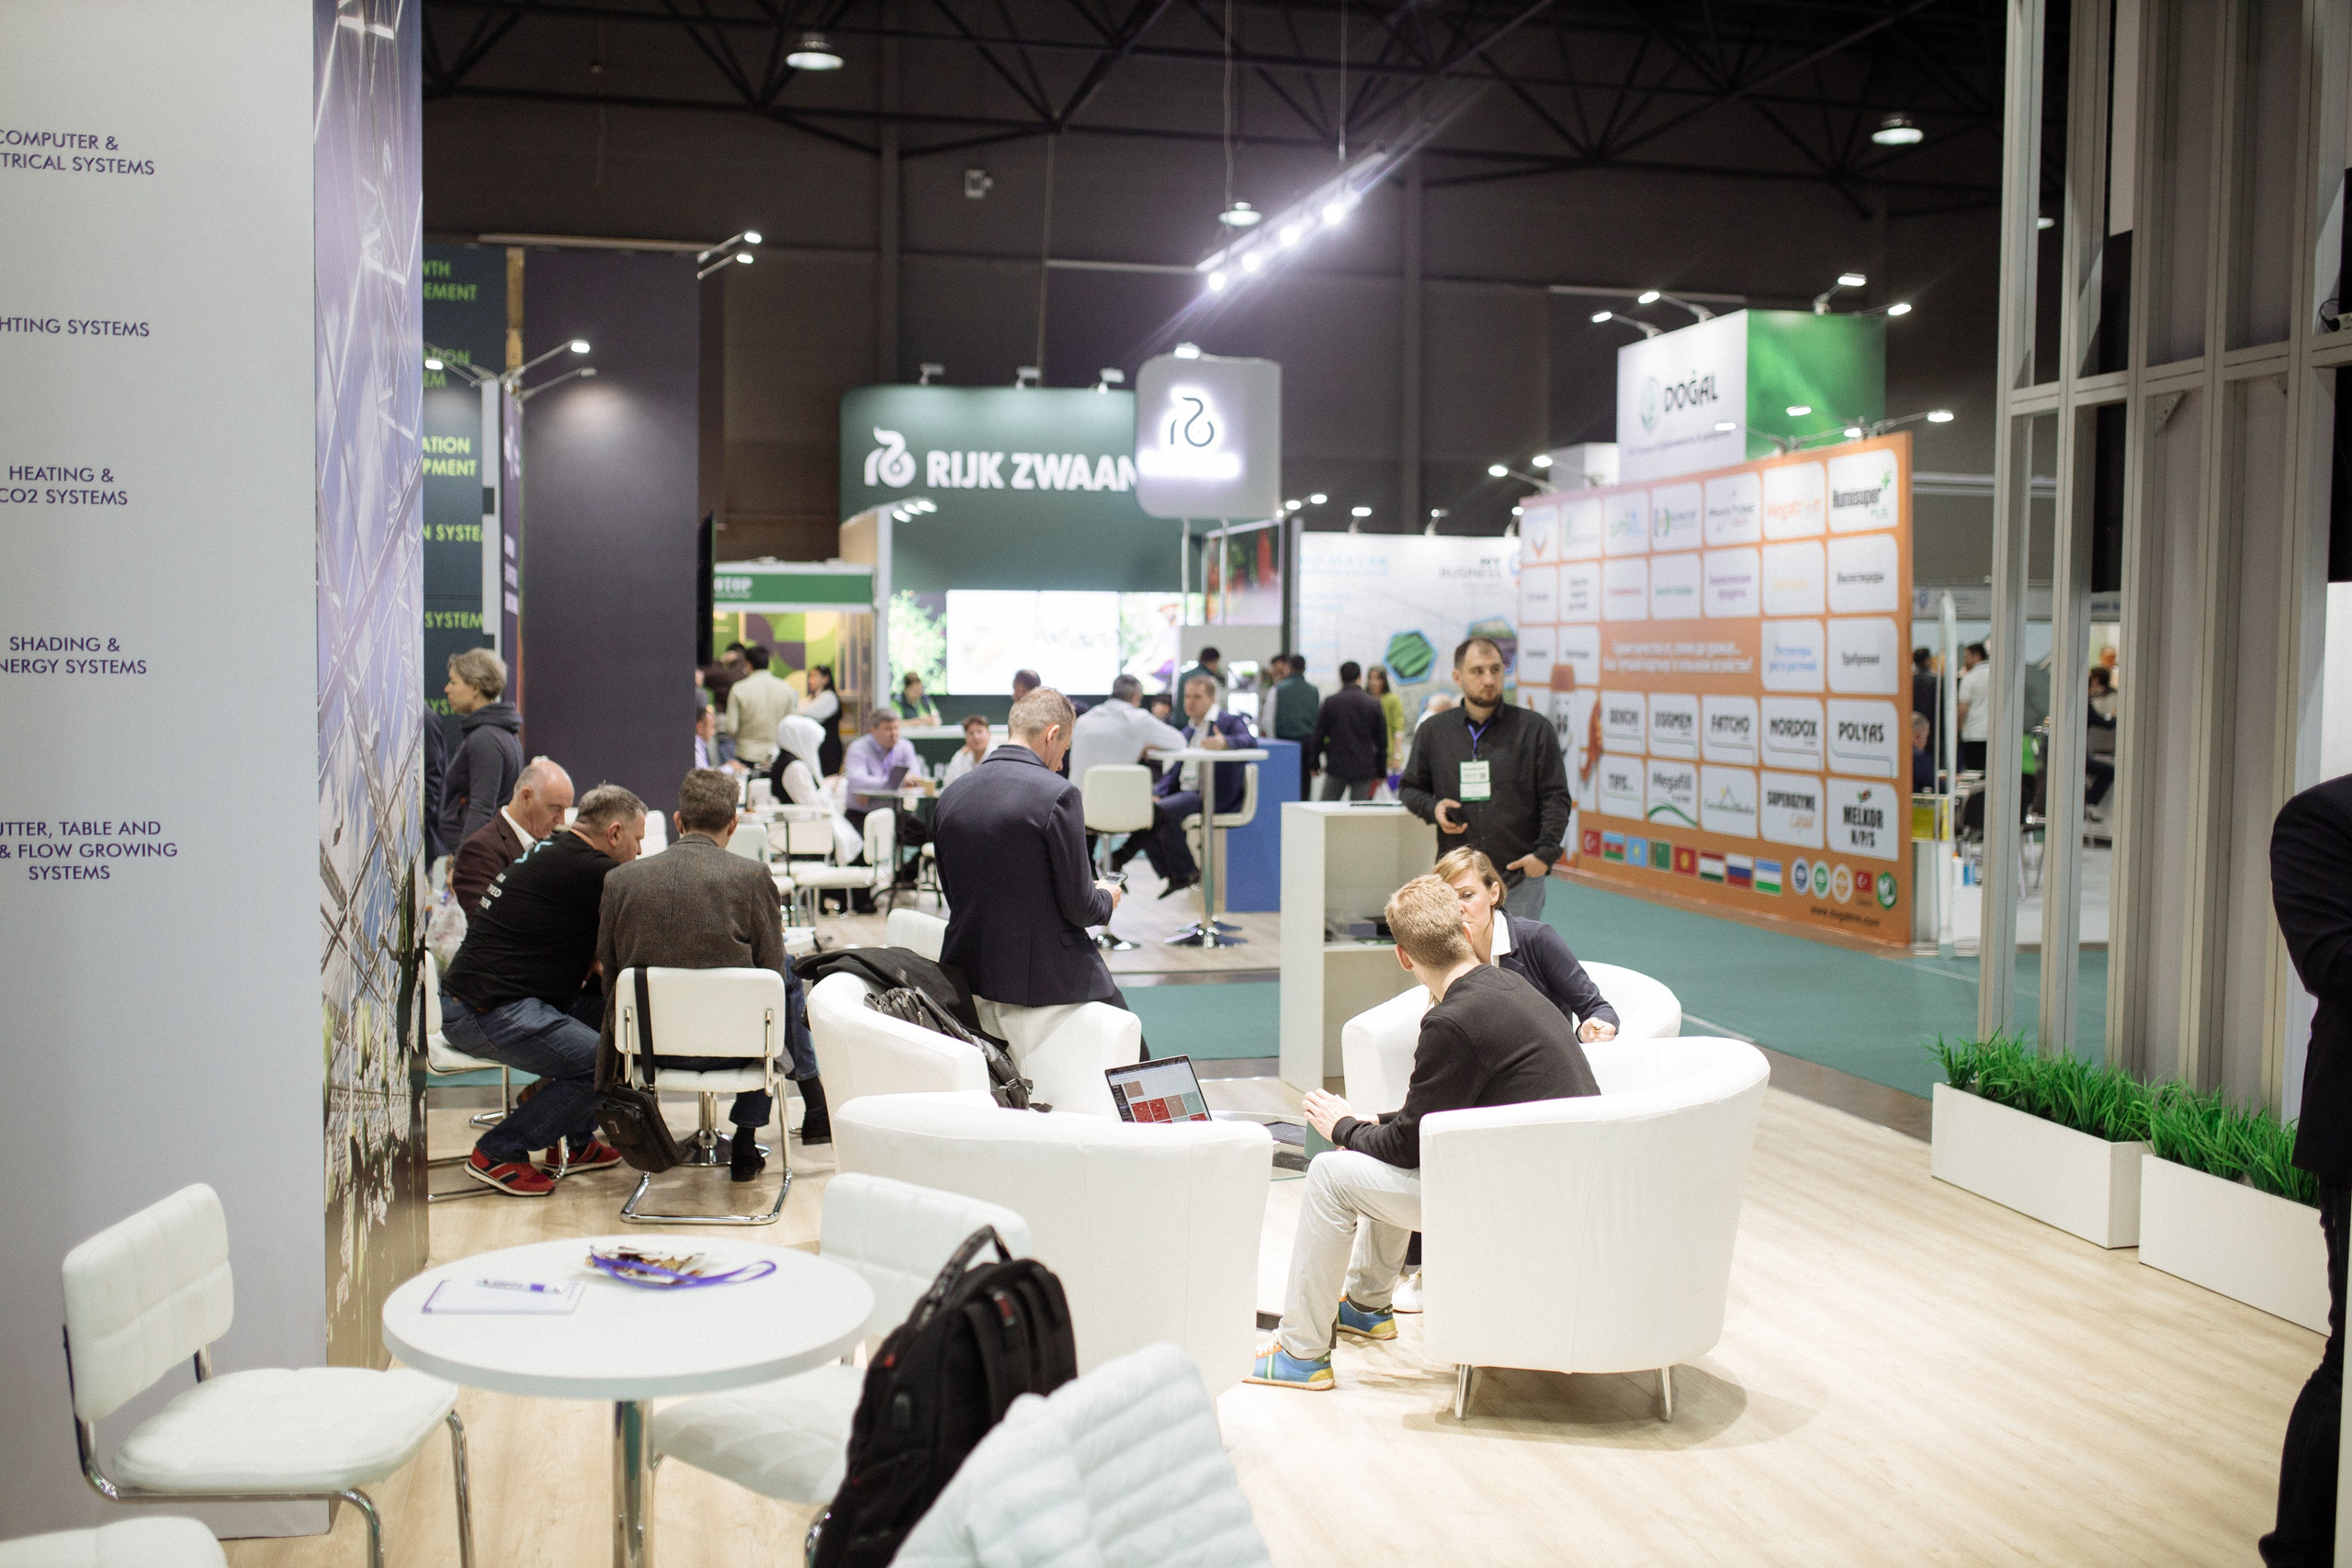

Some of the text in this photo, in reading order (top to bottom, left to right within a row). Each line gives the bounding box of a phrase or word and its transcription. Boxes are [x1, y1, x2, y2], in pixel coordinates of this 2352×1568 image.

[105, 135, 119, 151] &
[73, 156, 155, 175] SYSTEMS
[0, 317, 150, 337] HTING SYSTEMS
[9, 466, 114, 483] HEATING &
[423, 458, 477, 477] PMENT
[926, 450, 1137, 492] RIJK ZWAAN
[46, 489, 129, 505] SYSTEMS
[9, 636, 120, 652] SHADING &
[65, 660, 147, 674] SYSTEMS
[1838, 721, 1884, 745] POLYAS
[0, 821, 162, 839] TTER, TABLE AND
[18, 843, 73, 858] FLOW
[79, 842, 178, 858] GROWING
[28, 865, 111, 881] SYSTEMS
